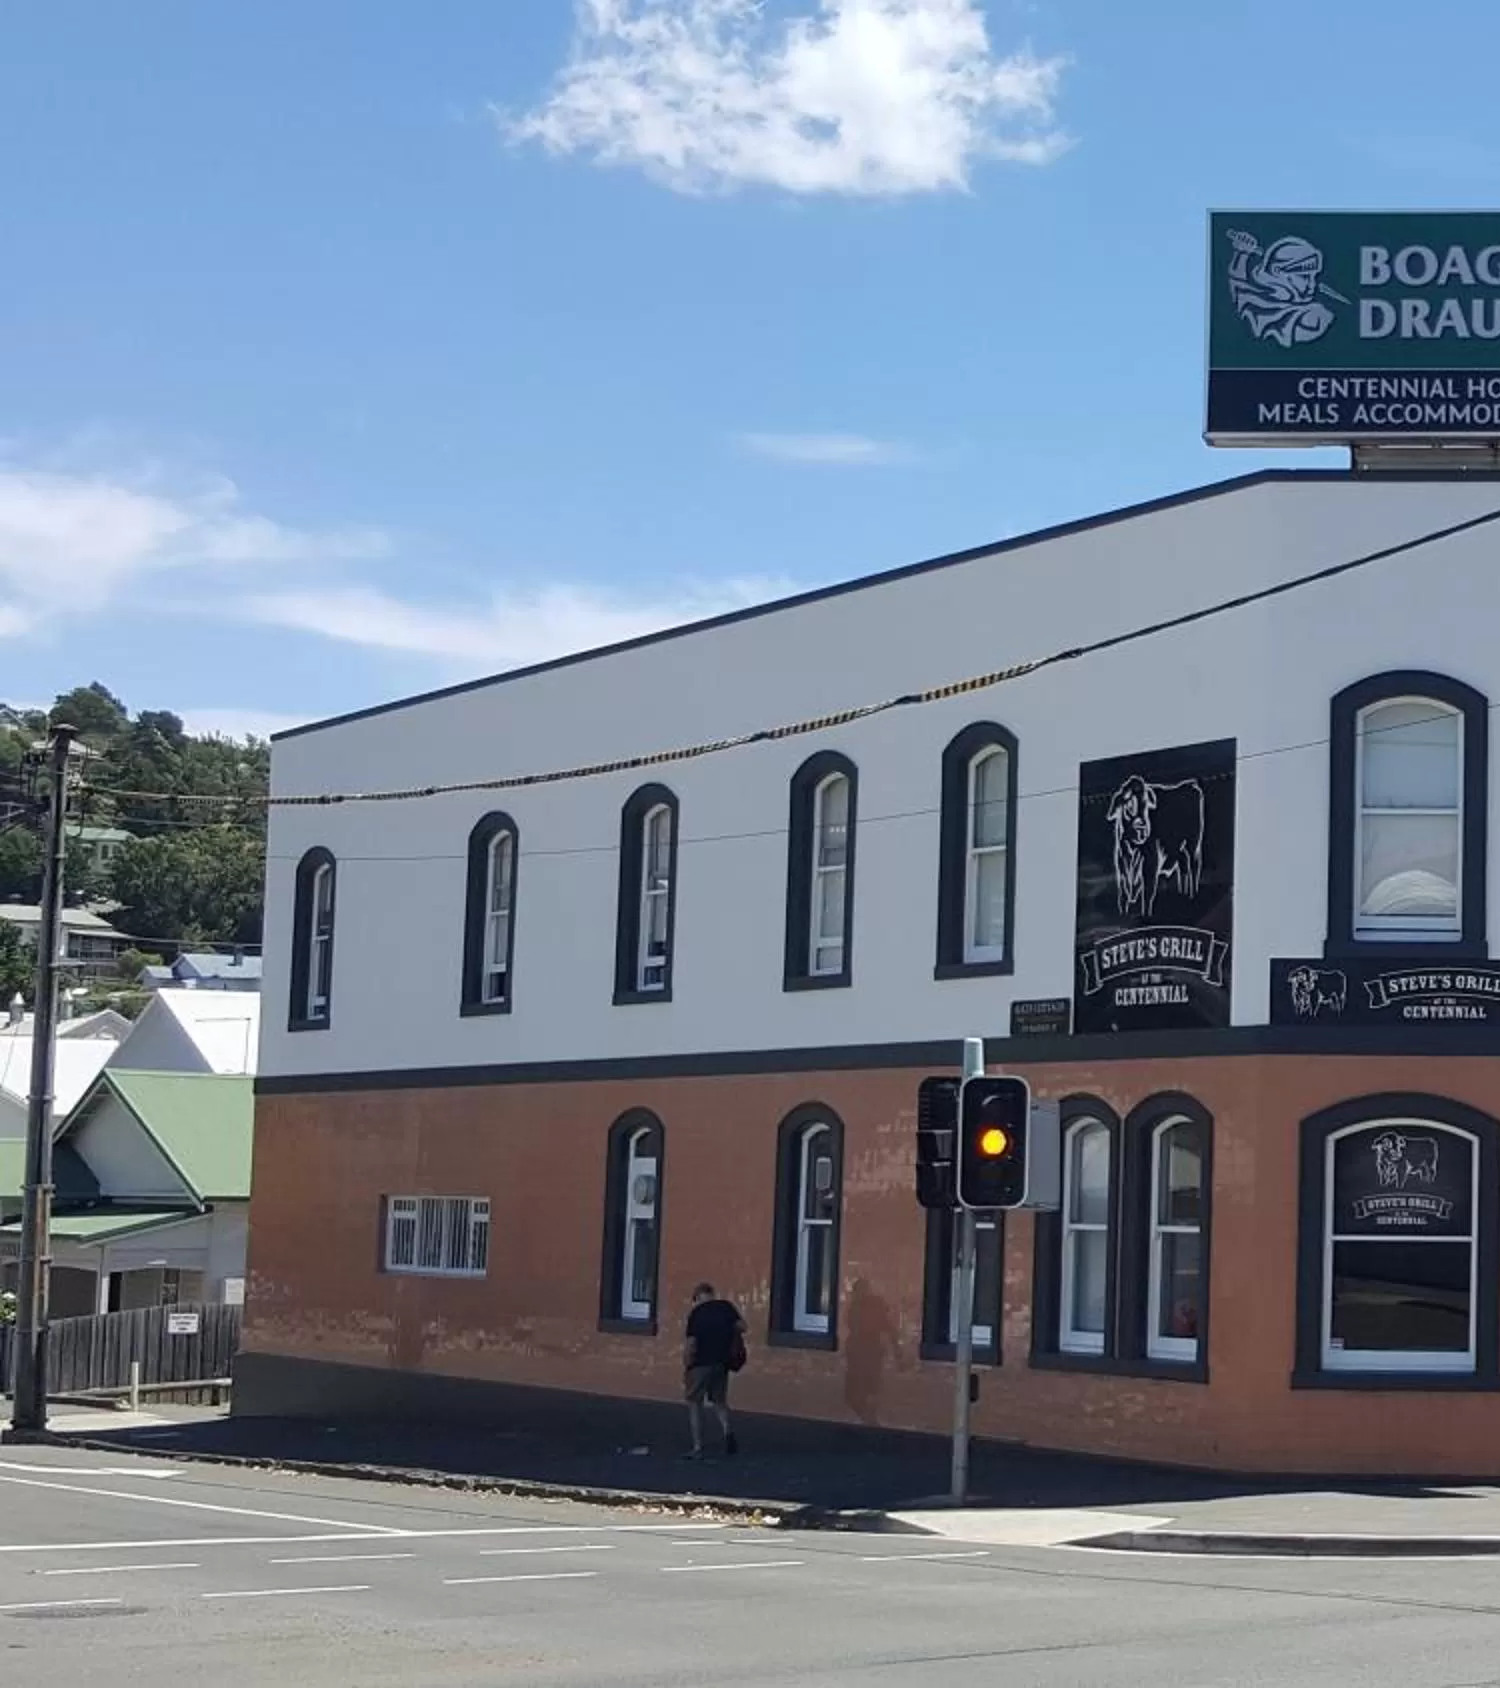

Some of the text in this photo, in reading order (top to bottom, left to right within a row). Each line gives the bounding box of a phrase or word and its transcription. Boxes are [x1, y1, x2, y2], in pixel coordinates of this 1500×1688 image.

[1298, 377, 1460, 400] CENTENNIAL
[1258, 404, 1339, 425] MEALS
[1102, 937, 1203, 969] STEVE'S GRILL
[1389, 974, 1451, 993] STEVE'S
[1115, 984, 1189, 1006] CENTENNIAL
[1403, 1006, 1487, 1019] CENTENNIAL
